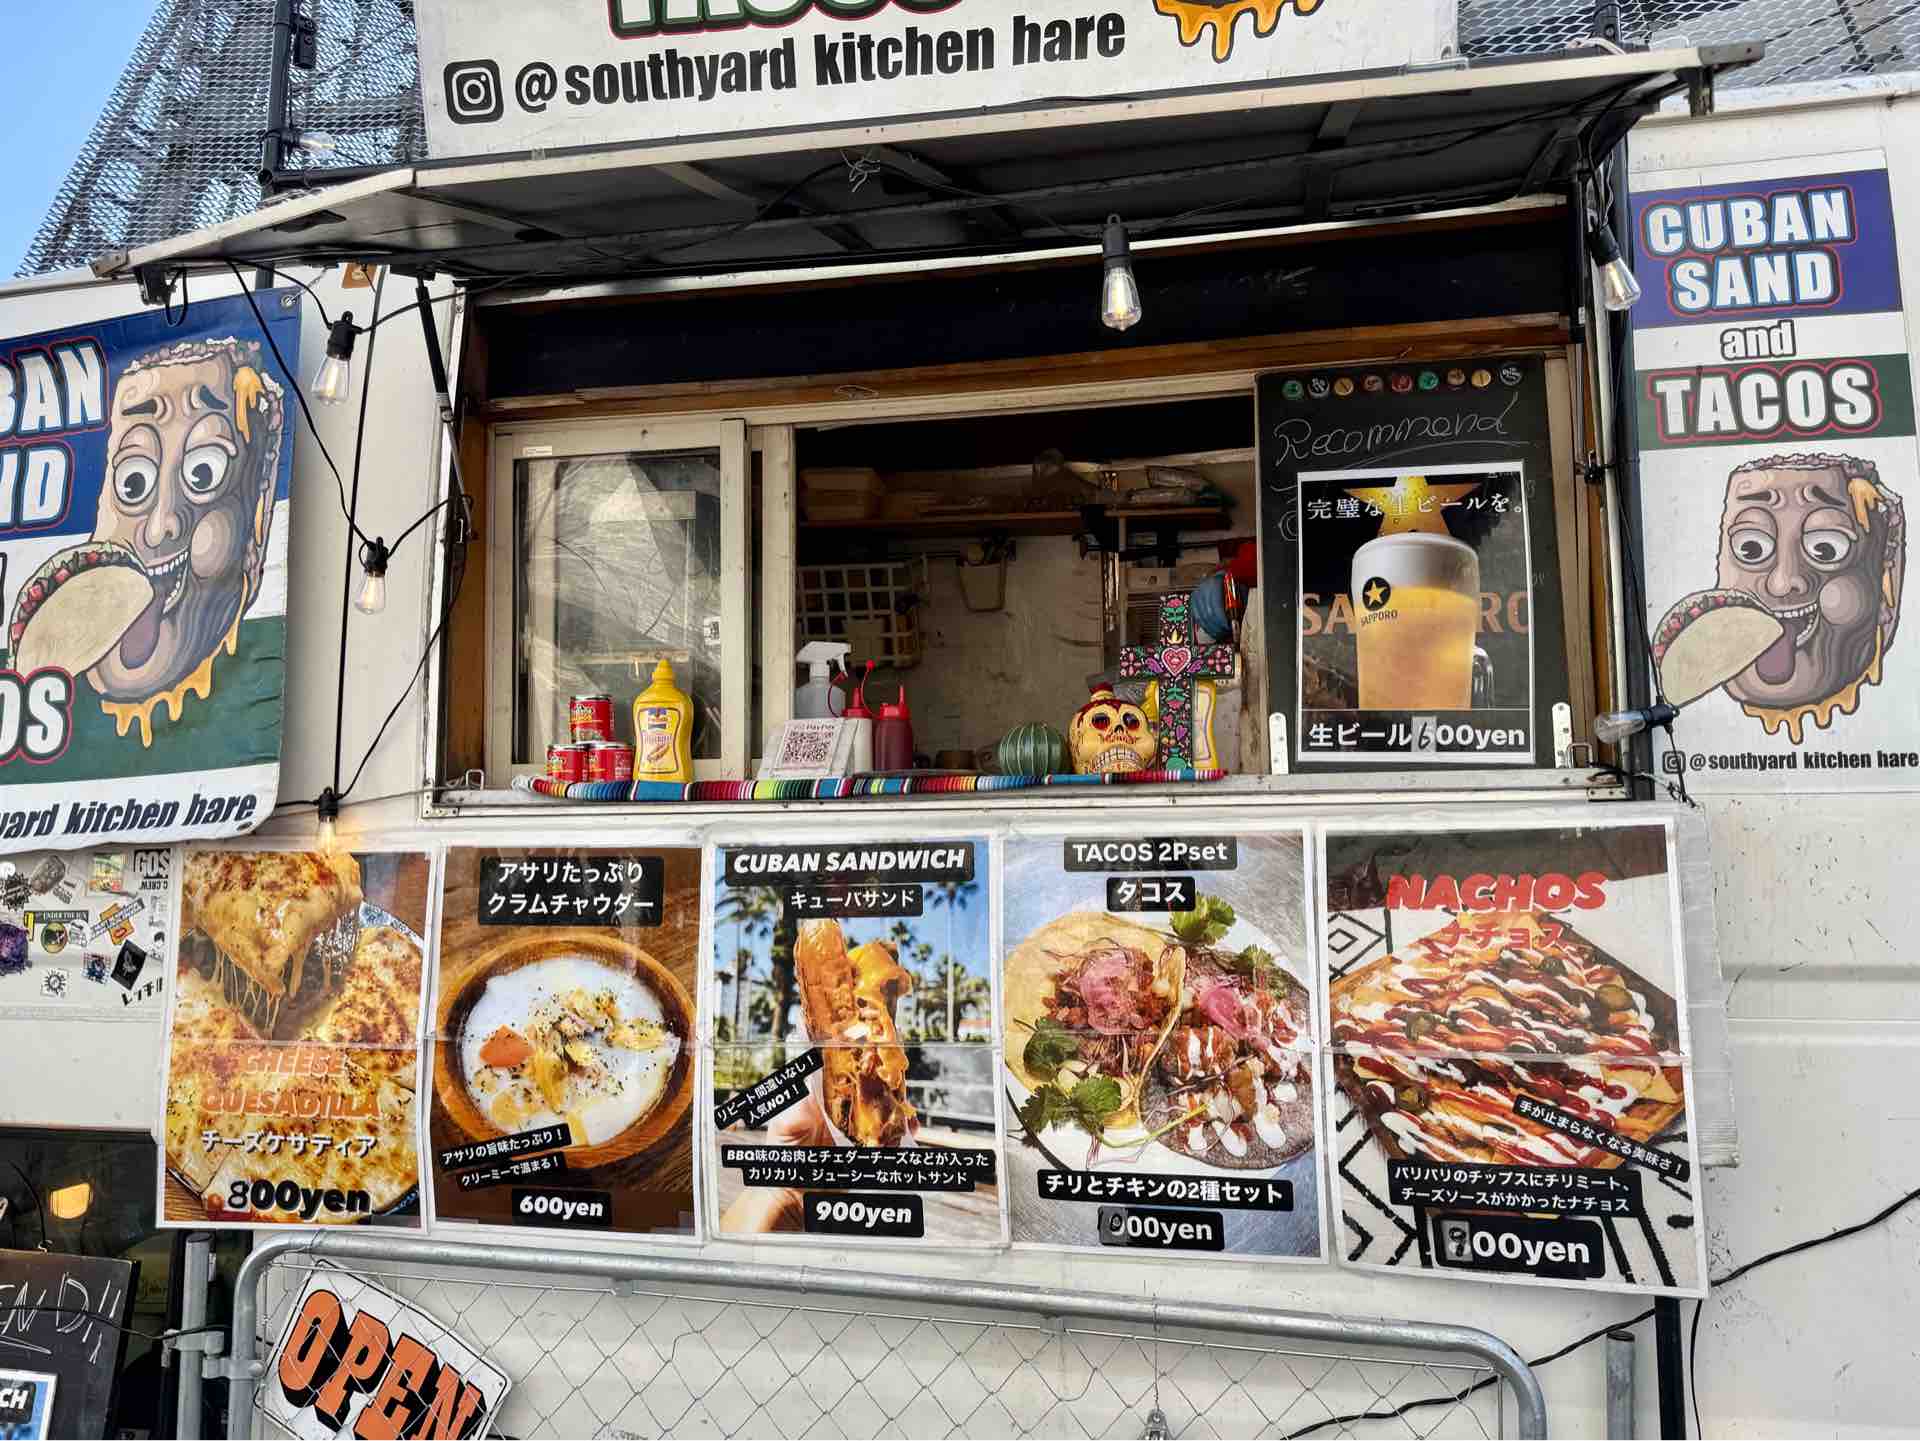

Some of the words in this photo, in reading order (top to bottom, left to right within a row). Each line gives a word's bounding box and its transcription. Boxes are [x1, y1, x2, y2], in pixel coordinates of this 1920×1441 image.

[514, 39, 797, 113] @southyard
[815, 25, 995, 87] kitchen
[1011, 12, 1126, 66] hare
[1647, 189, 1851, 254] CUBAN
[1672, 252, 1834, 310] SAND
[1720, 319, 1797, 361] and
[1655, 367, 1873, 434] TACOS
[1690, 751, 1798, 771] @southyard
[1803, 751, 1872, 769] kitchen
[1877, 750, 1919, 768] hare
[0, 803, 60, 839] ard
[62, 798, 180, 834] kitchen
[182, 793, 257, 826] hare
[734, 853, 820, 874] CUBAN
[825, 848, 965, 872] SANDWICH
[1072, 843, 1153, 863] TACOS
[1158, 841, 1229, 861] 2Pset
[498, 861, 643, 883] アサリたっぷり
[487, 892, 654, 916] クラムチャウダー
[790, 890, 915, 909] キューバサンド
[1117, 881, 1186, 903] タコス
[1386, 872, 1608, 913] NACHOS
[1440, 921, 1566, 951] ナチョス
[243, 1049, 350, 1075] CHEESE
[201, 1088, 384, 1119] QUESADILLA
[201, 1130, 377, 1157] チーズケサディア
[228, 1179, 372, 1220] 800yen
[519, 1195, 604, 1221] 600yen
[816, 1201, 912, 1228] 900yen
[277, 1289, 488, 1441] OPEN
